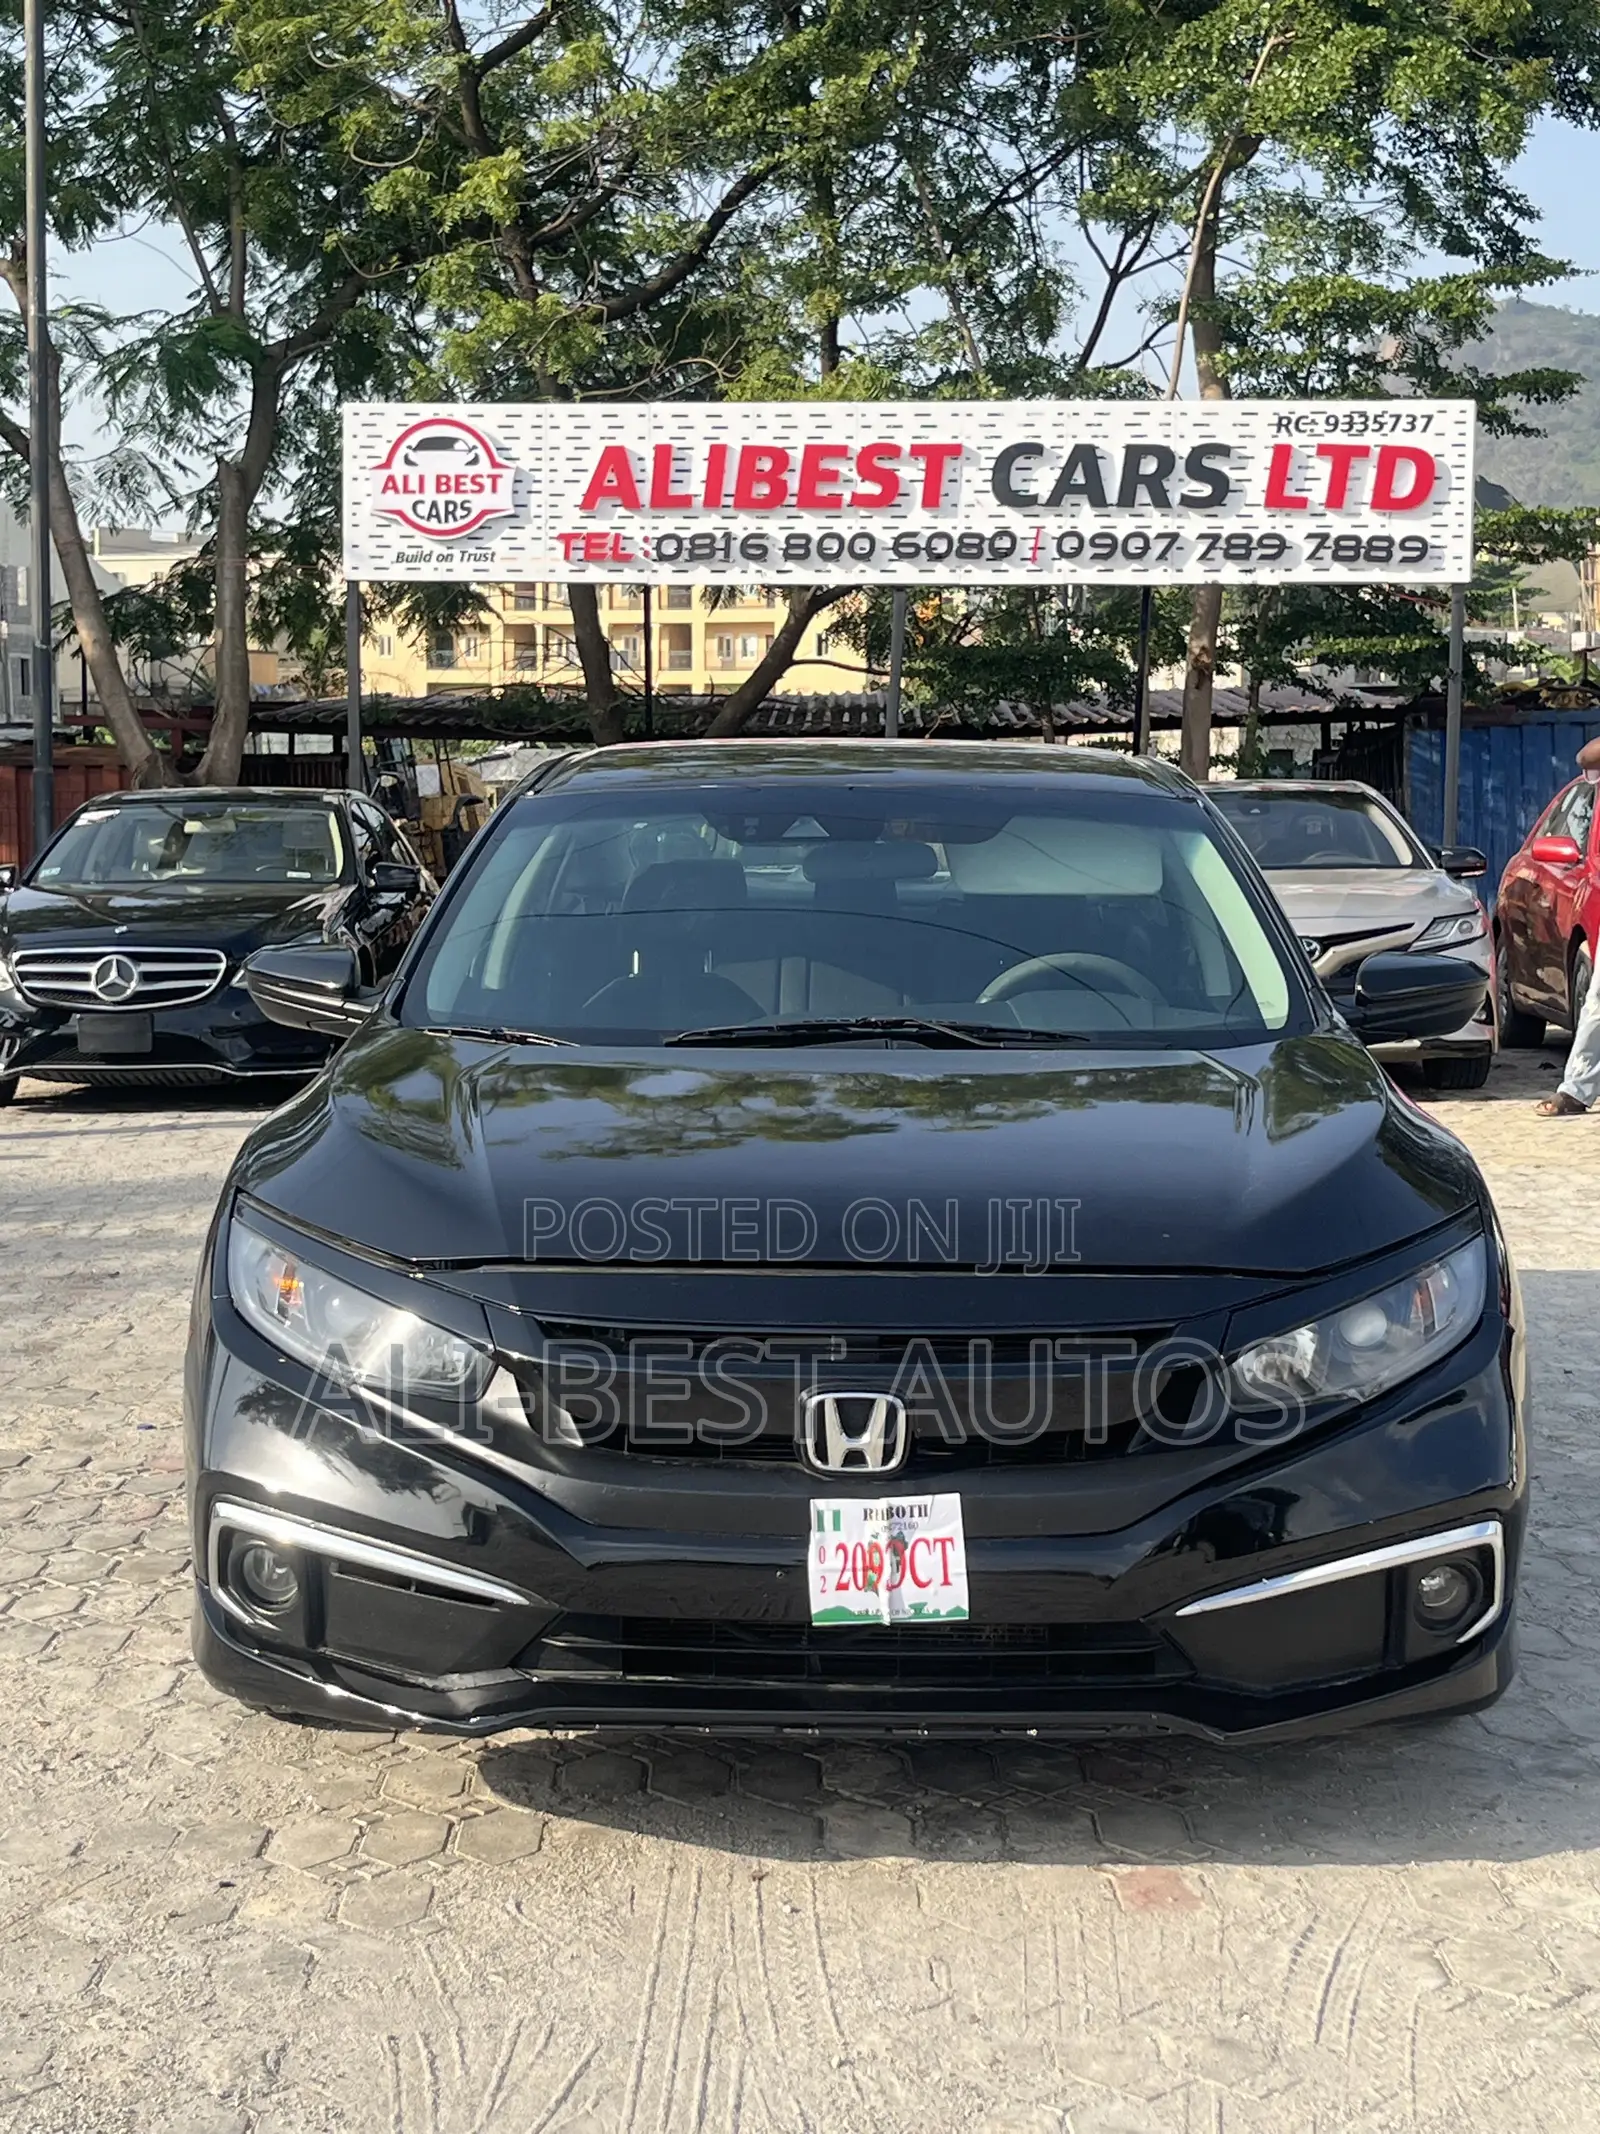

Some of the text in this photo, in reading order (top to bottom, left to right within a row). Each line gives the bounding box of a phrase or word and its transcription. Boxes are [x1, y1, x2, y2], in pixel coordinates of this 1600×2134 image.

[1324, 413, 1434, 433] 9335737
[381, 474, 503, 494] ALI BEST
[580, 442, 1436, 511] ALIBEST CARS LTD
[411, 500, 472, 524] CARS
[396, 549, 496, 564] Build on Trust
[655, 531, 769, 562] 0816
[782, 531, 876, 562] 800
[891, 531, 1018, 562] 6080
[1055, 531, 1181, 562] 0907
[1195, 531, 1288, 562] 789
[1303, 531, 1430, 564] 7889
